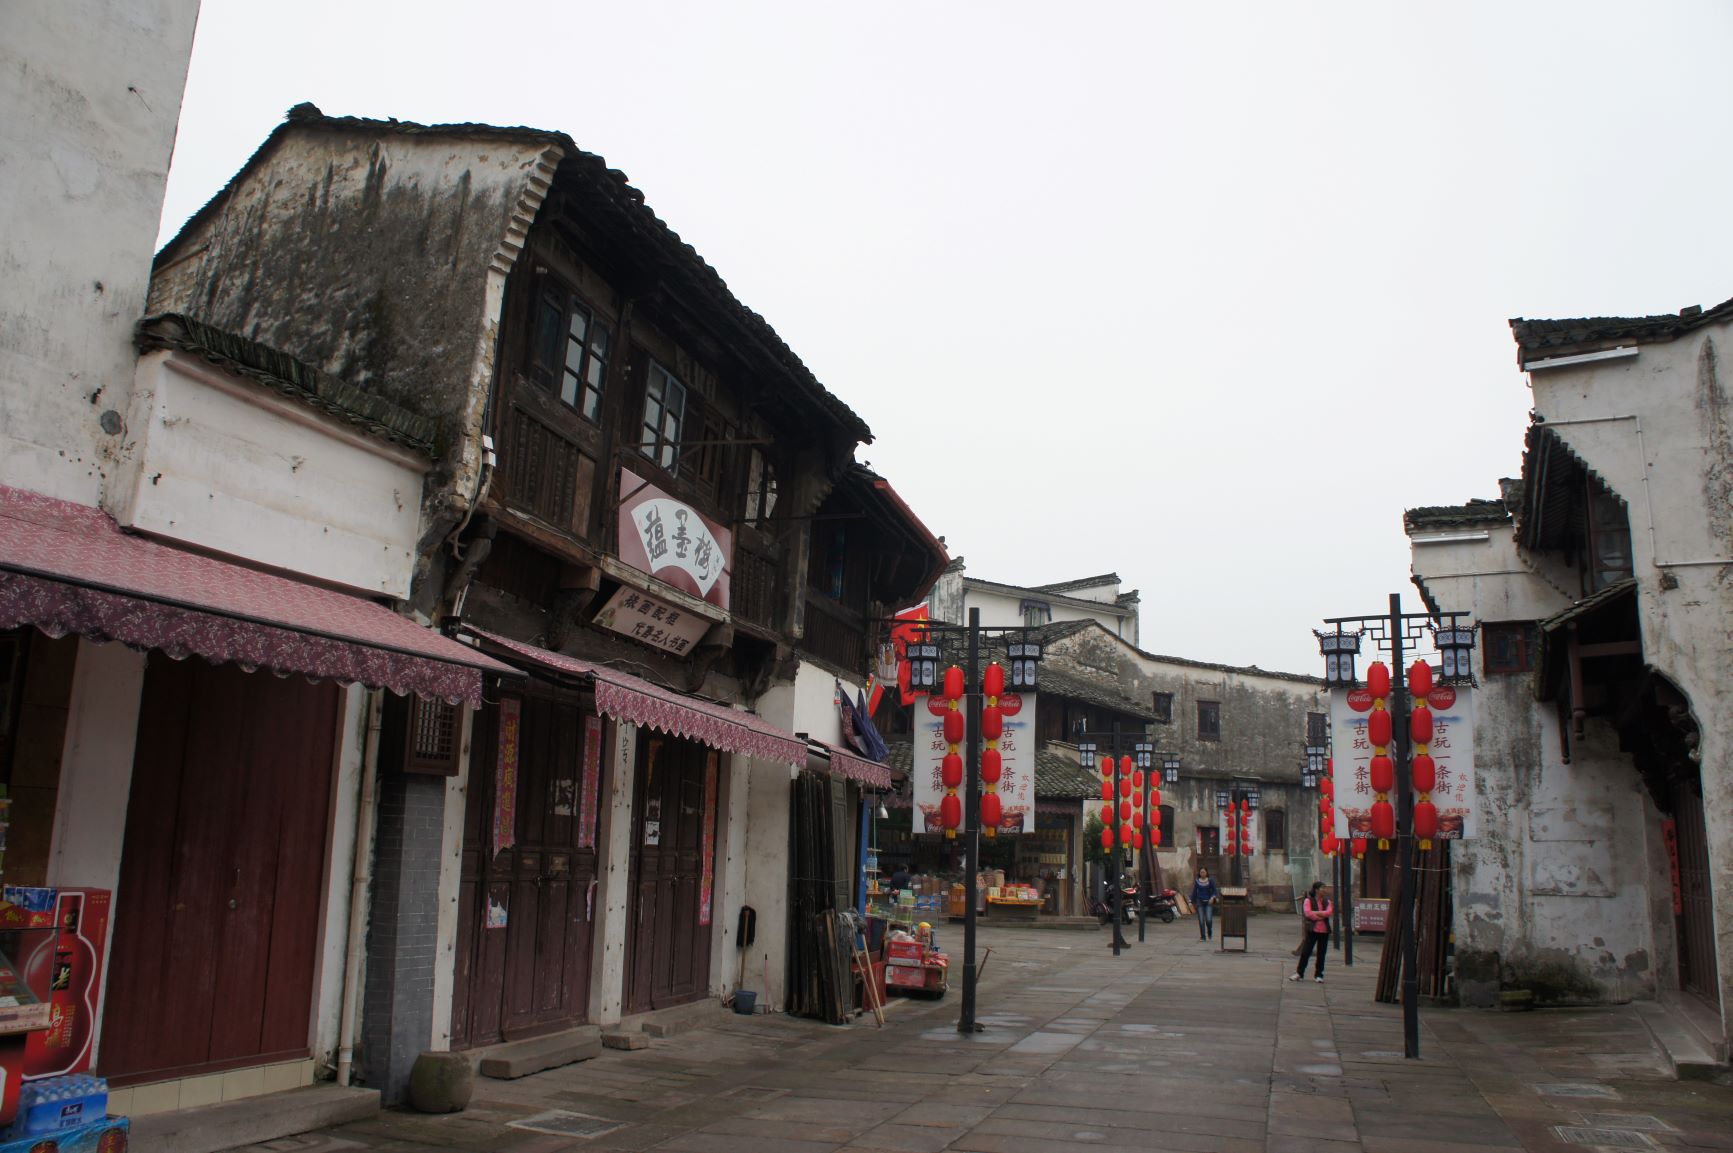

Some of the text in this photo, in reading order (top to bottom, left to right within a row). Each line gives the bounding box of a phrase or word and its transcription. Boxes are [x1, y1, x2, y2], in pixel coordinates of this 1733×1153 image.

[931, 726, 946, 793] 古玩一条街
[1001, 726, 1017, 794] 古玩一条街
[1353, 722, 1370, 795] 古玩一条街
[1434, 721, 1453, 795] 古玩一条街
